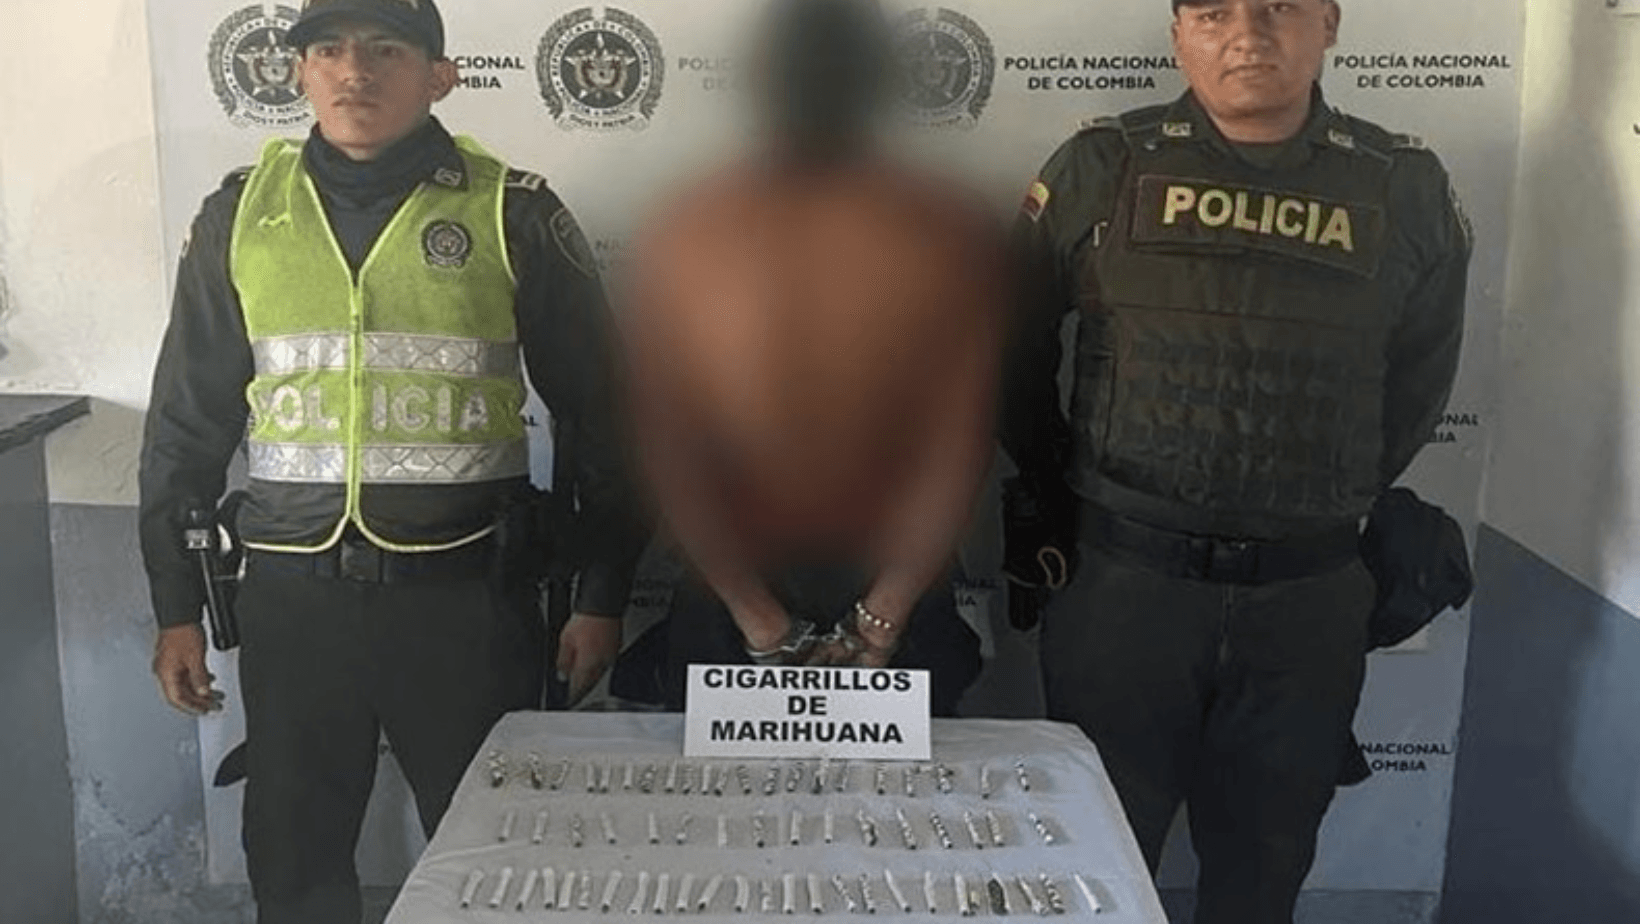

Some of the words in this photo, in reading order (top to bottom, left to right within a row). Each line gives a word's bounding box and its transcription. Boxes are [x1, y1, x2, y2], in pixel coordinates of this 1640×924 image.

[454, 55, 526, 70] CIONAL
[1004, 52, 1077, 71] POLICÍA
[1083, 55, 1181, 70] NACIONAL
[1334, 52, 1408, 70] POLICÍA
[1413, 54, 1511, 69] NACIONAL
[1028, 76, 1052, 90] DE
[1056, 76, 1156, 90] COLOMBIA
[1357, 74, 1381, 88] DE
[1386, 74, 1485, 88] COLOMBIA
[1162, 185, 1354, 252] POLICIA
[703, 668, 912, 692] CIGARRILLOS
[788, 695, 828, 716] DE
[710, 720, 903, 744] MARIHUANA
[1360, 742, 1452, 755] NACIONAL
[1371, 759, 1427, 772] OMBIA
